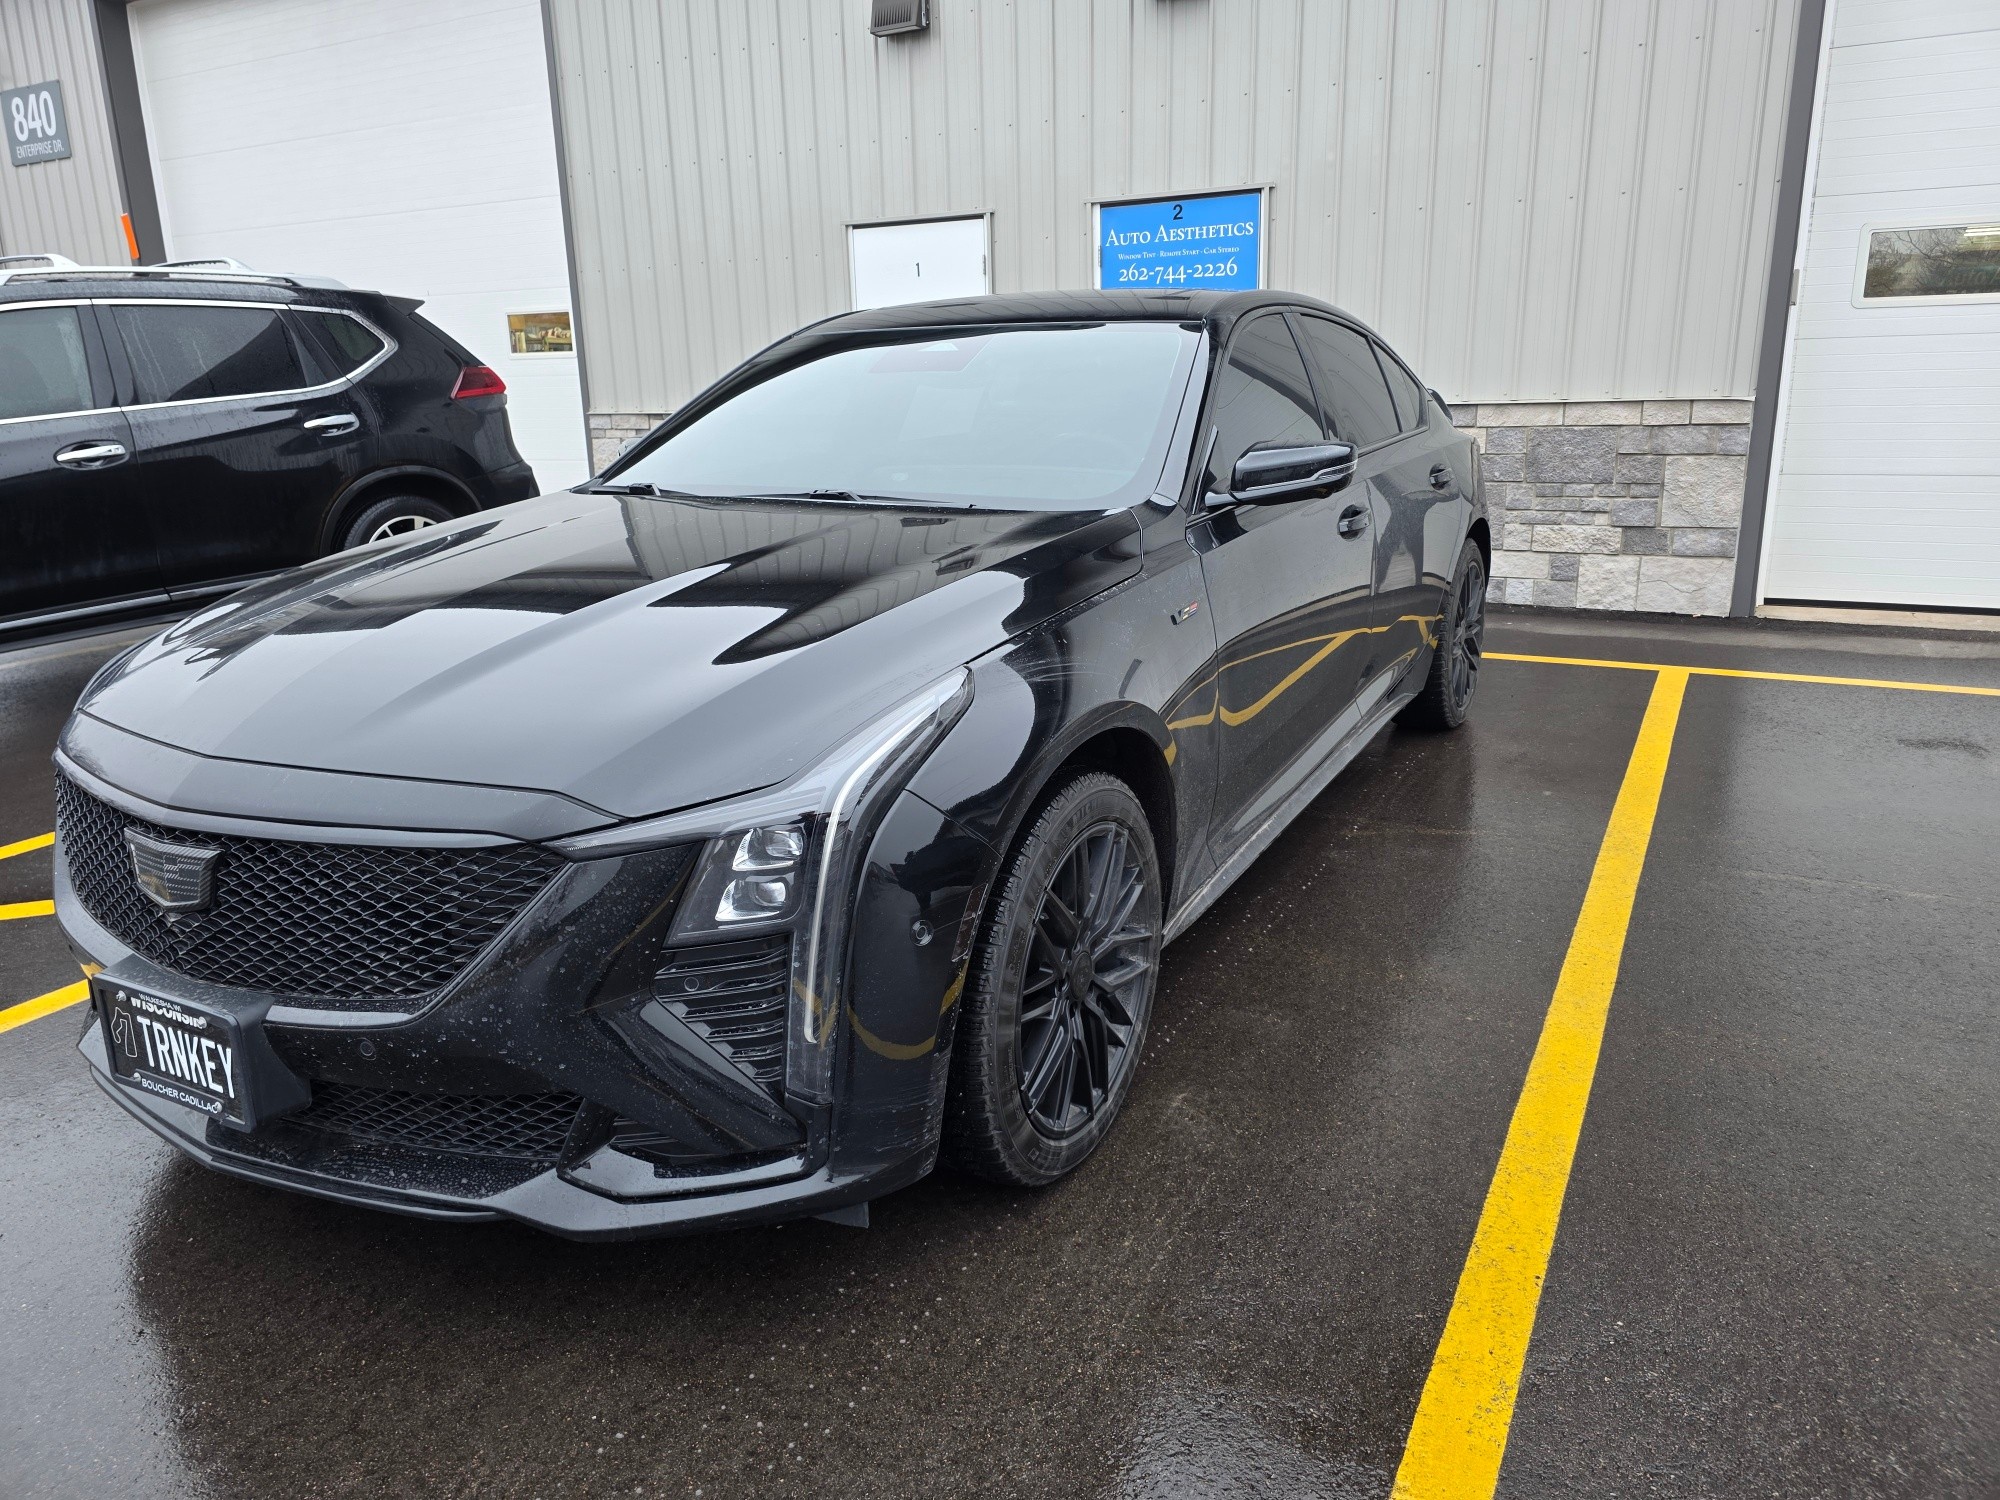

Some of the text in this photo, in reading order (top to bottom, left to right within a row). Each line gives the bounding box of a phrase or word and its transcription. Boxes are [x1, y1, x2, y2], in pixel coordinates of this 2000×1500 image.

[11, 90, 57, 142] 840
[16, 139, 65, 159] ENTERPRISE DR.
[1172, 204, 1184, 221] 2
[1105, 221, 1255, 247] AUTO AESTHETICS
[915, 262, 921, 277] 1
[1119, 256, 1238, 284] 262-744-2226
[136, 1015, 235, 1099] TRNKEY
[141, 1078, 220, 1114] BOUCHER CADILLAC
